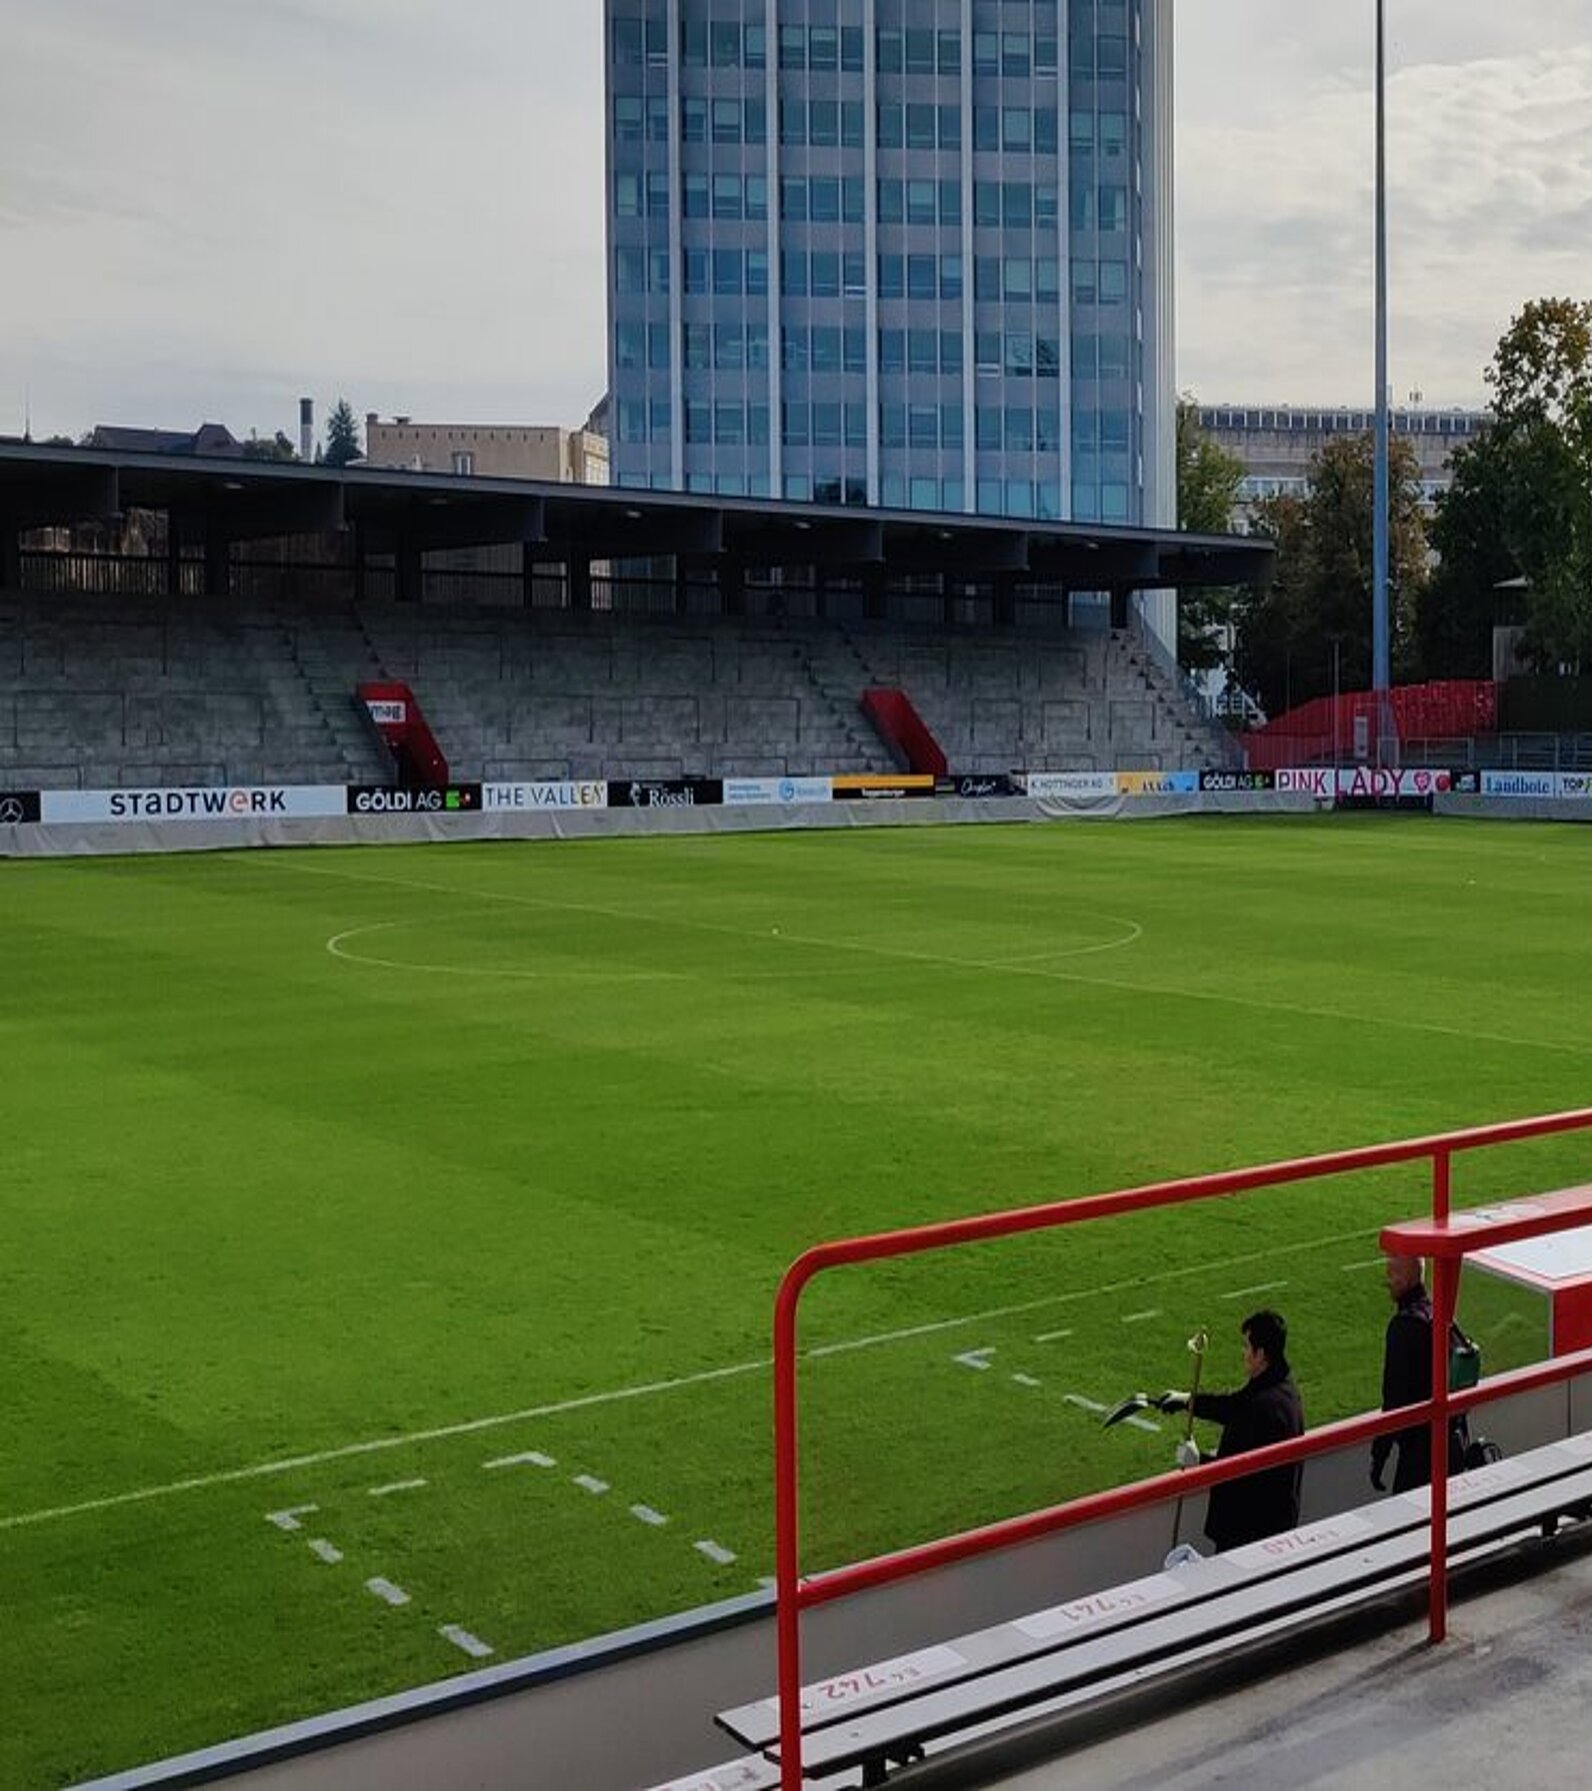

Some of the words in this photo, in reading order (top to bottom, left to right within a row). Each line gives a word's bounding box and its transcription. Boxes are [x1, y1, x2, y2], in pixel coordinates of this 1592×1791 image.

[1278, 771, 1327, 794] PINK
[1335, 767, 1404, 801] LADY
[1485, 775, 1550, 794] Landbote
[355, 787, 412, 811] GÖLDI
[415, 790, 443, 810] AG
[485, 787, 525, 807] THE
[648, 786, 695, 807] Rössli
